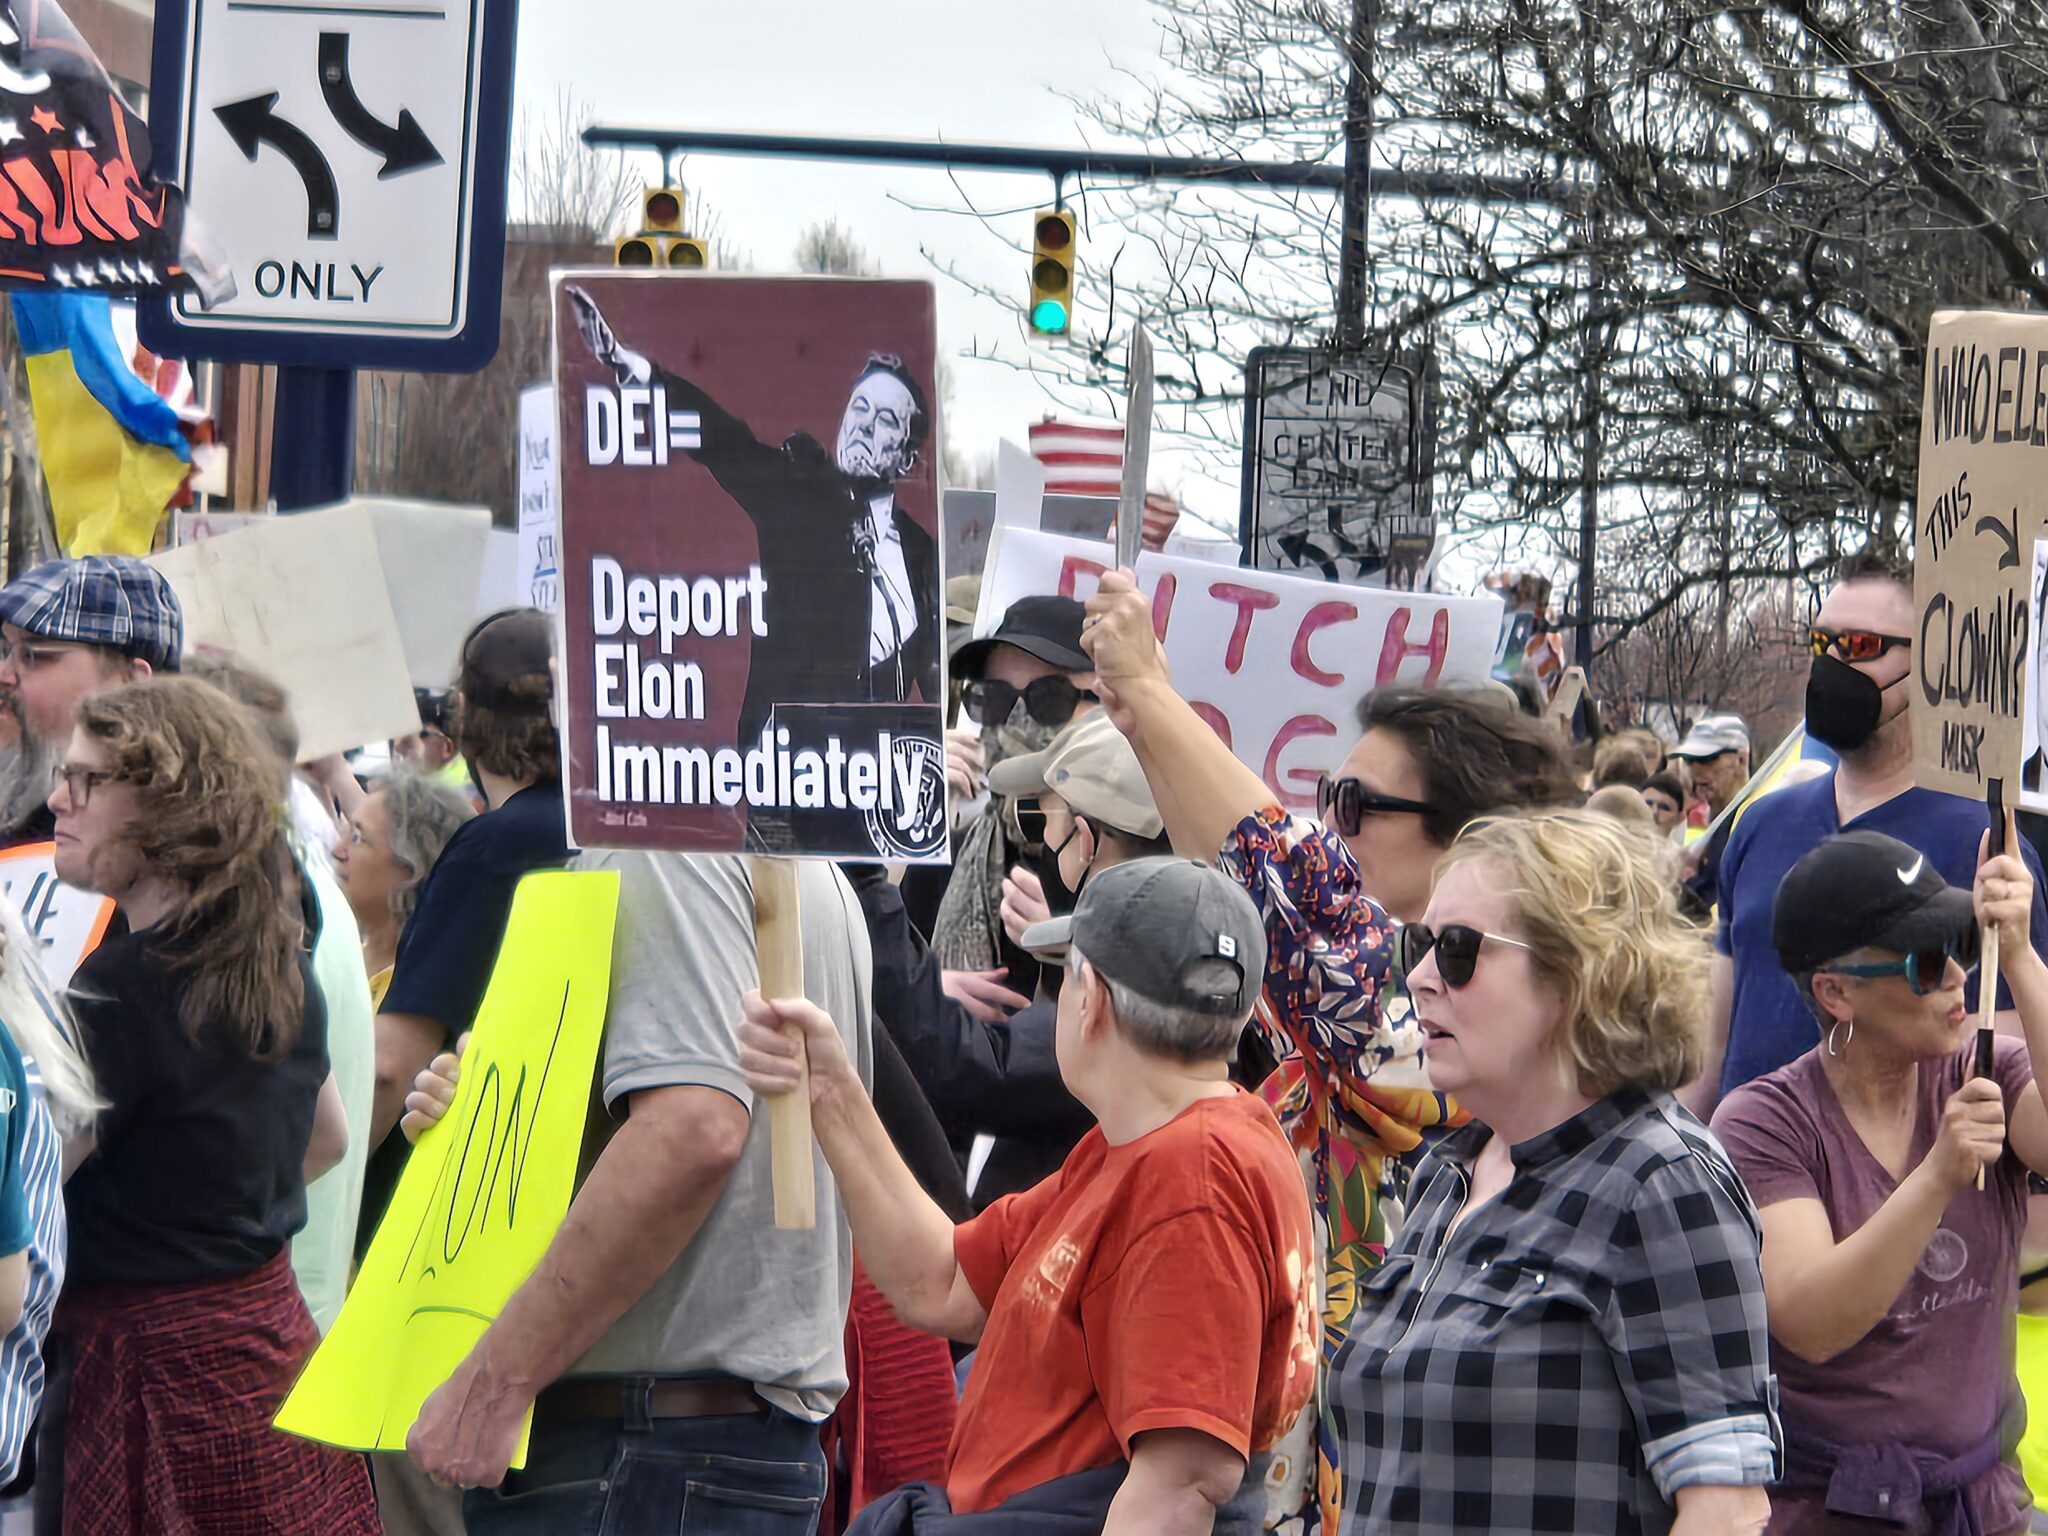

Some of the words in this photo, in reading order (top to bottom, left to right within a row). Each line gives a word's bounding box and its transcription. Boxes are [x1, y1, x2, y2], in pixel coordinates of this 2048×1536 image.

[255, 261, 384, 303] ONLY
[586, 384, 701, 466] DEI=
[1932, 344, 1992, 445] WHO
[1992, 346, 2048, 447] ELE
[1925, 471, 1972, 562] THIS
[592, 558, 767, 655] Deport
[1921, 588, 2029, 718] CLOWN?
[595, 644, 705, 720] Elon
[598, 727, 924, 831] Immediately
